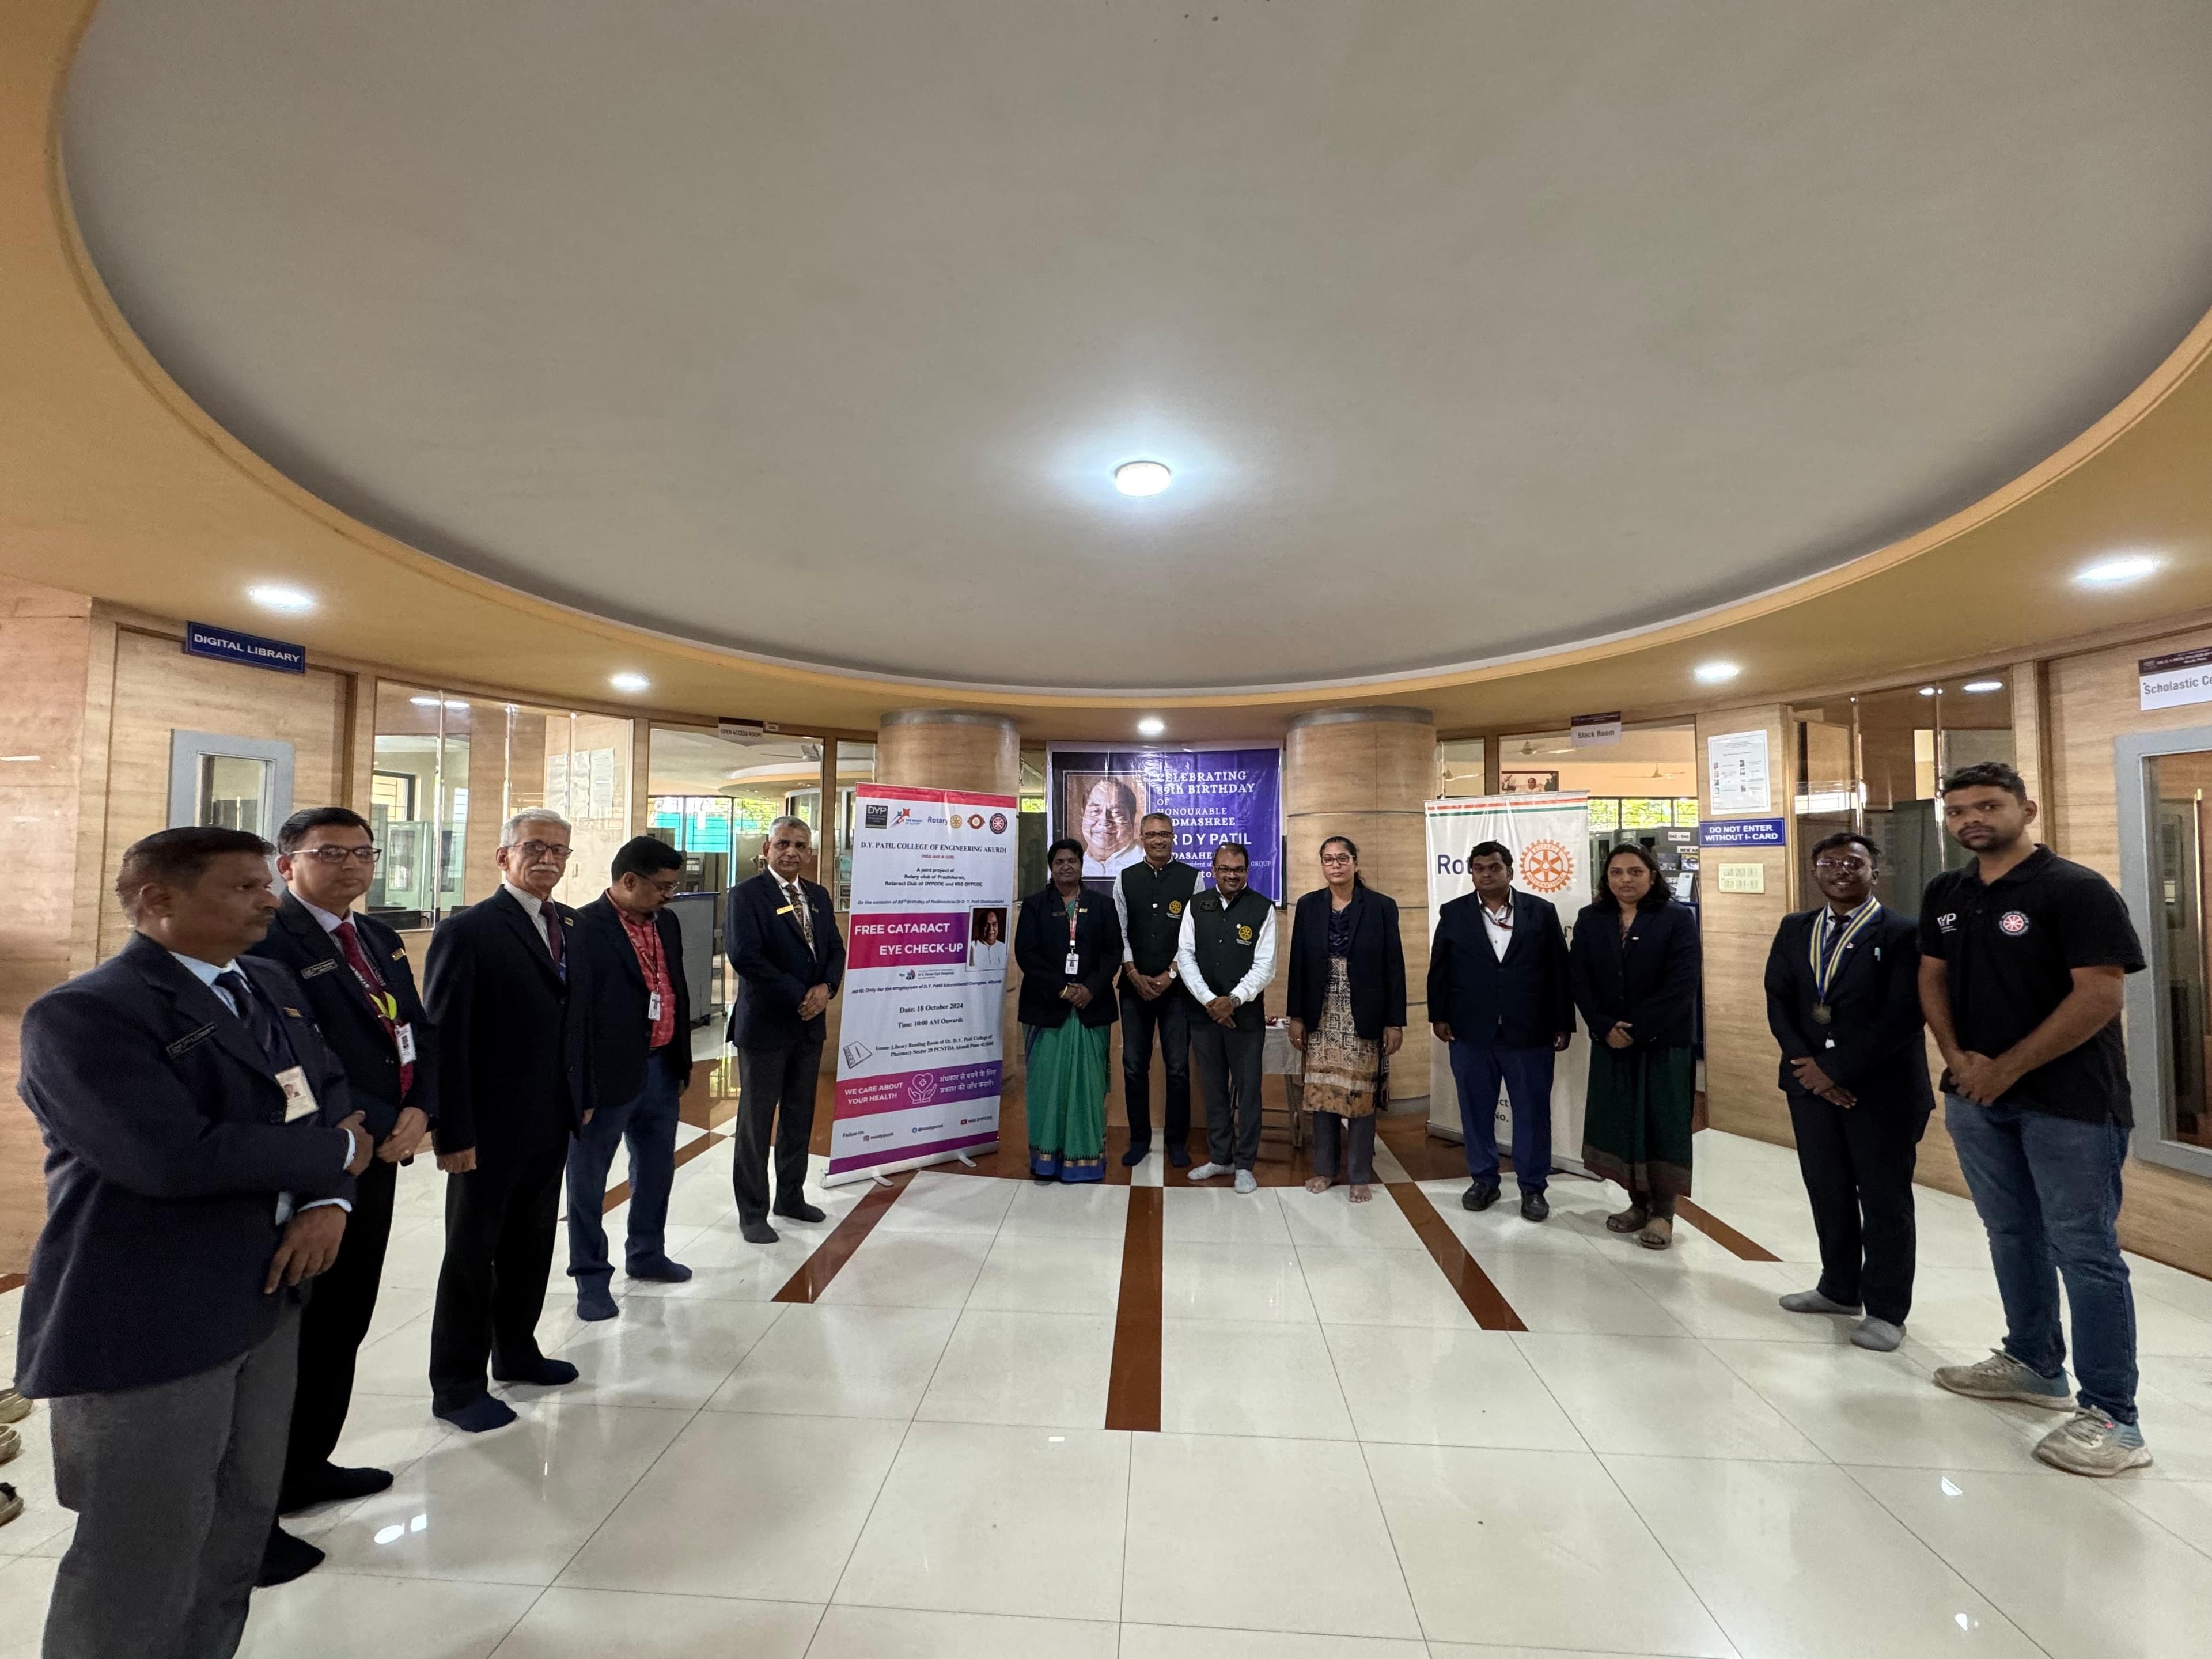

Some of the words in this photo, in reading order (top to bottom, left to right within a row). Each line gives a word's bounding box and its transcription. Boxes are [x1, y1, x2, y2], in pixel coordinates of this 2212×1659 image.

[194, 633, 244, 652] DIGITAL
[247, 644, 300, 662] LIBRARY
[2144, 677, 2199, 695] Scholastic
[1157, 771, 1247, 782] CELEBRATING
[1157, 783, 1184, 795] 89th
[1188, 783, 1255, 794] BIRTHDAY
[1157, 798, 1170, 806] OF
[868, 806, 887, 815] DYP
[1157, 808, 1227, 816] HONOURABLE
[927, 816, 948, 825] Rotary
[1172, 817, 1236, 827] DMASHREE
[1743, 824, 1773, 832] ENTER
[1182, 834, 1193, 846] D
[1196, 833, 1206, 846] Y
[1210, 832, 1252, 846] PATIL
[1172, 851, 1213, 860] DASAHE
[1437, 854, 1473, 874] Rot
[854, 924, 885, 935] FREE
[887, 923, 950, 934] CATARACT
[879, 945, 903, 955] EYE
[904, 942, 964, 955] CHECK-UP
[940, 1016, 963, 1024] Onwards
[858, 1085, 878, 1094] CARE
[878, 1082, 903, 1091] ABOUT
[957, 1082, 965, 1090] की
[848, 1096, 868, 1105] YOUR
[869, 1092, 897, 1101] HEALTH
